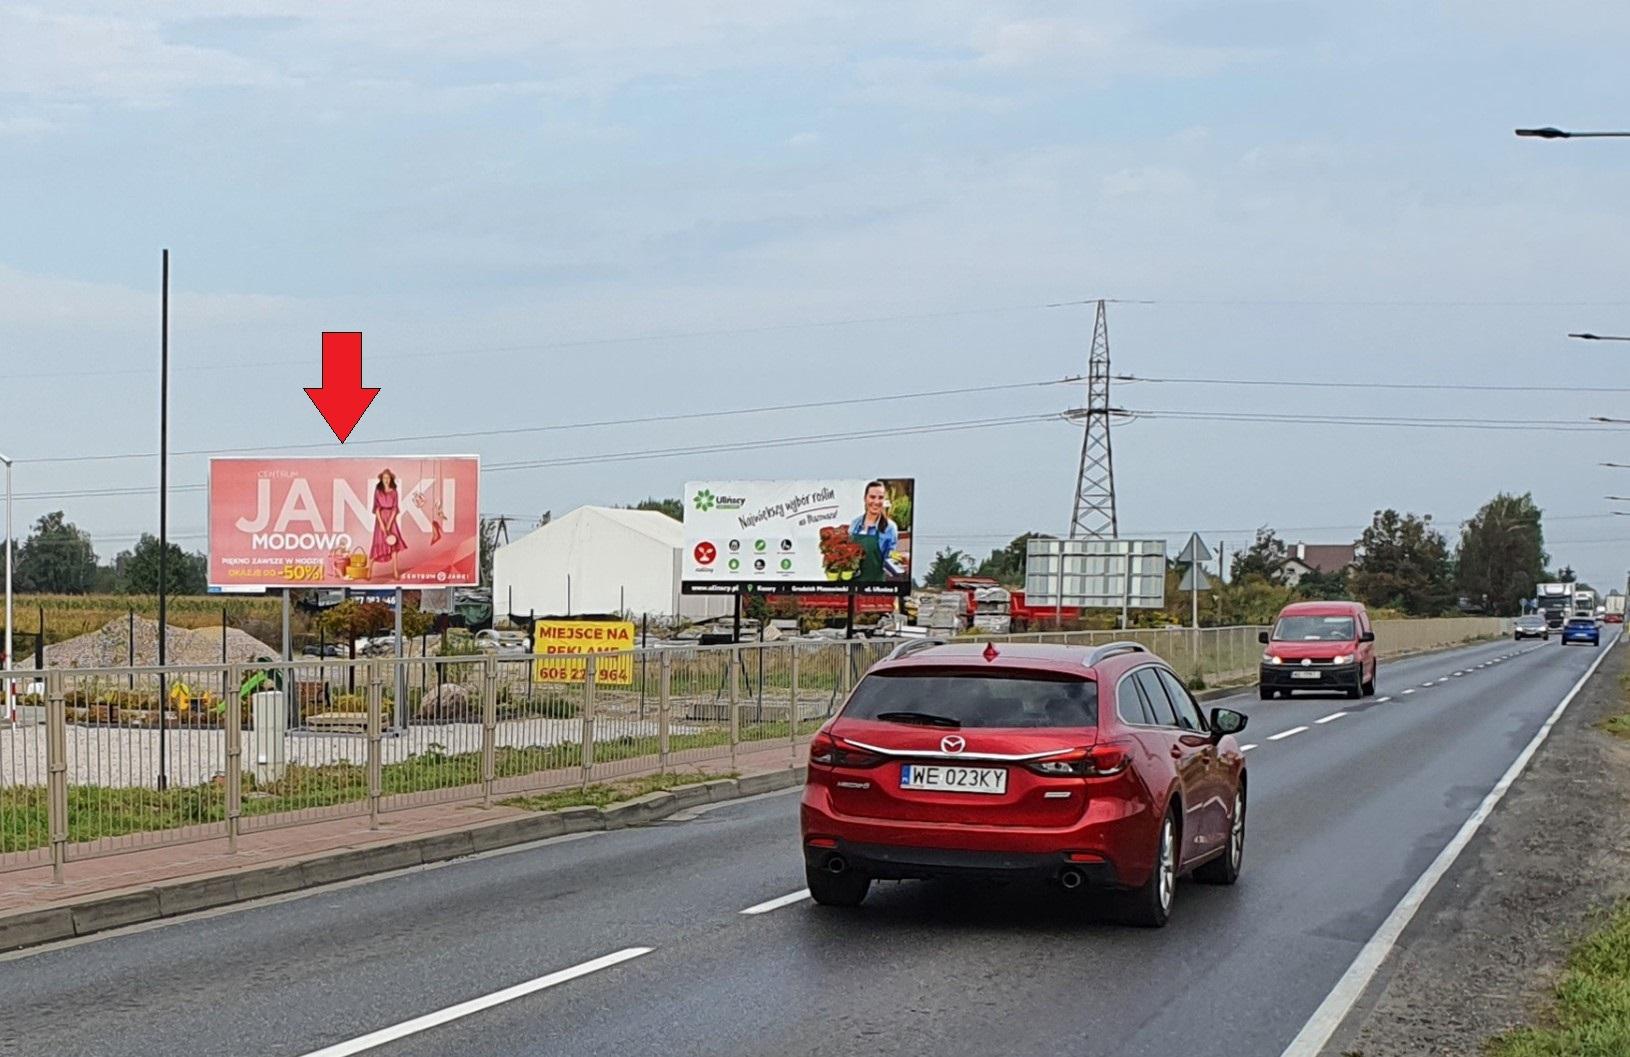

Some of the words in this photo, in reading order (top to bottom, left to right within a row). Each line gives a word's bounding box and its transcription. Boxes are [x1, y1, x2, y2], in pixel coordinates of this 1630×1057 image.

[235, 478, 455, 533] JANKI
[252, 533, 352, 550] MODOWO
[277, 564, 325, 581] -50%!
[540, 626, 603, 640] MIEJSCE
[607, 627, 630, 640] NA
[913, 767, 939, 785] WE
[945, 768, 1004, 788] 023KY
